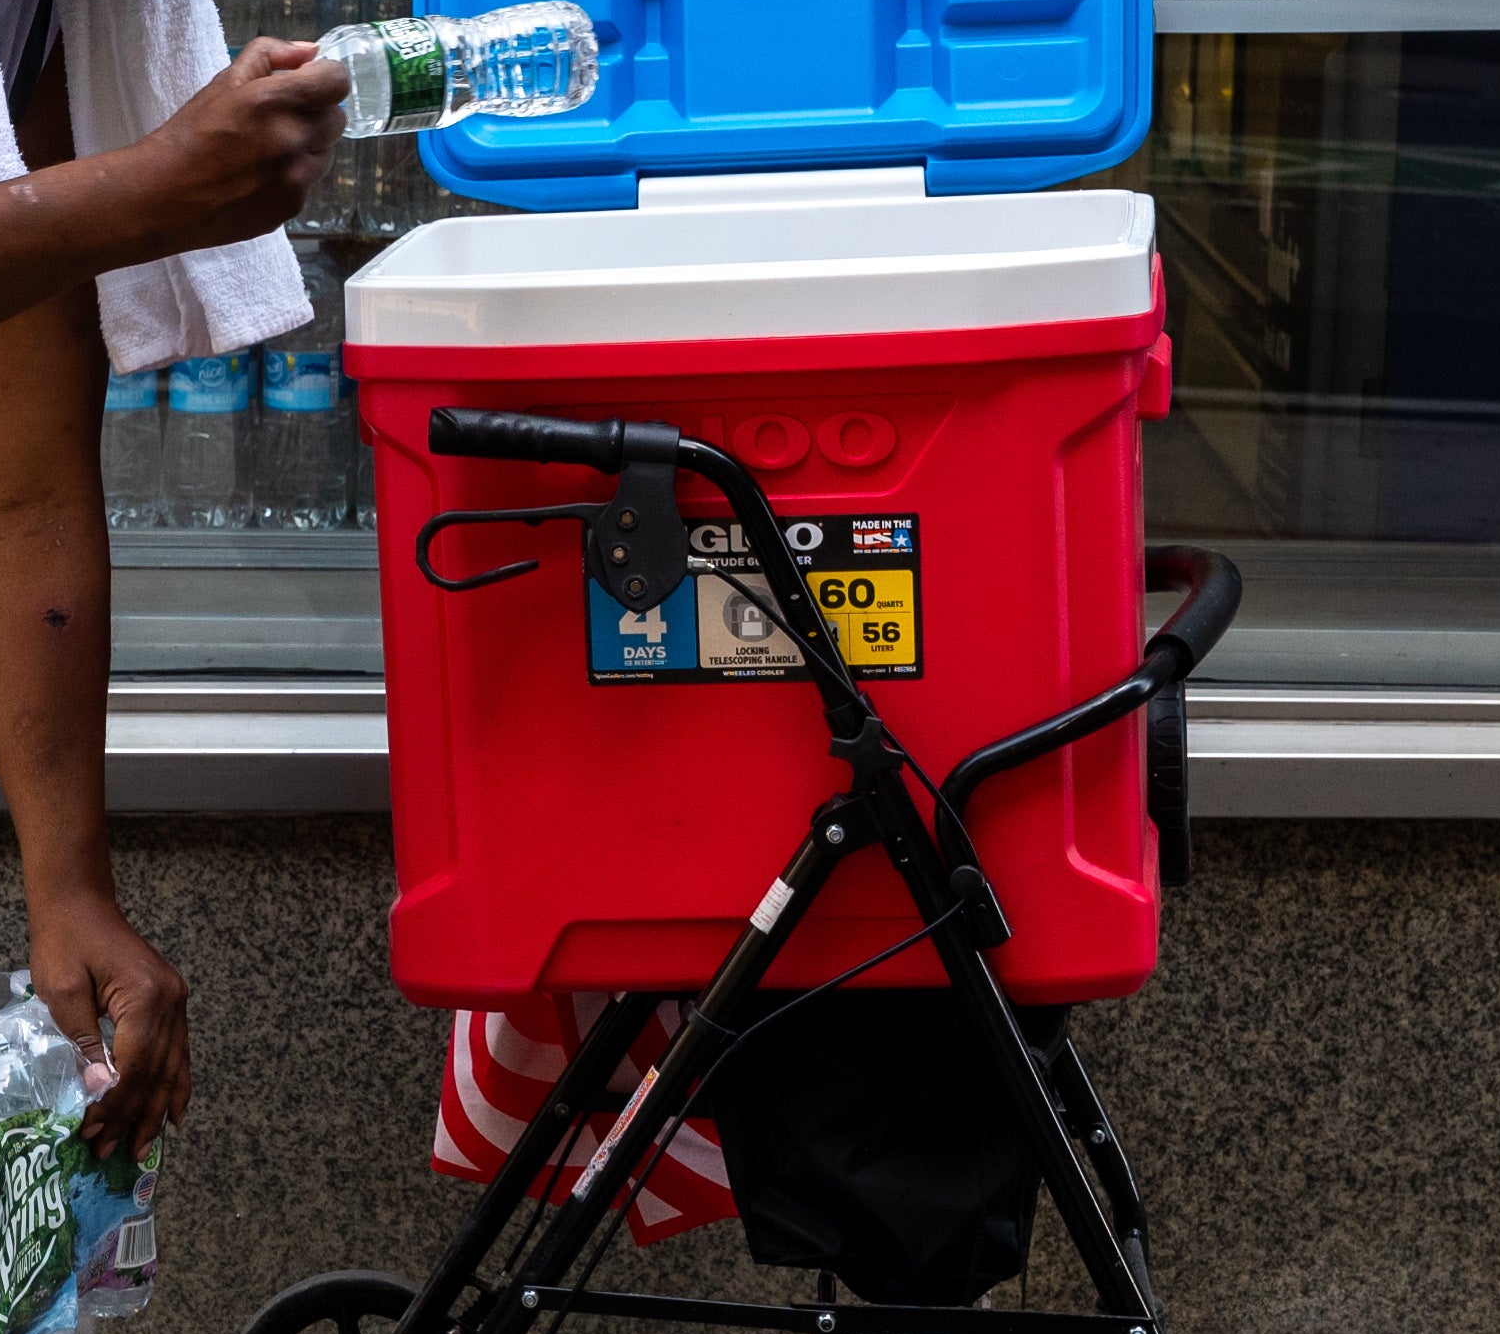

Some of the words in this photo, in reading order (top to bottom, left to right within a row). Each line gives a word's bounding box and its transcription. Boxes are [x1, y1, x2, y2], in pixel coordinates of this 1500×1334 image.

[852, 519, 881, 531] MADE
[882, 519, 892, 530] IN
[893, 519, 913, 530] THE
[819, 577, 876, 610] 60
[876, 599, 905, 610] QUARTS
[618, 603, 668, 644] 4
[862, 621, 901, 644] 56
[623, 646, 667, 659] DAYS
[735, 646, 770, 656] LOCKING
[870, 643, 895, 653] LITERS
[709, 655, 764, 666] TELESCOPING
[765, 655, 798, 665] HANDLE
[14, 1239, 42, 1285] WATER
